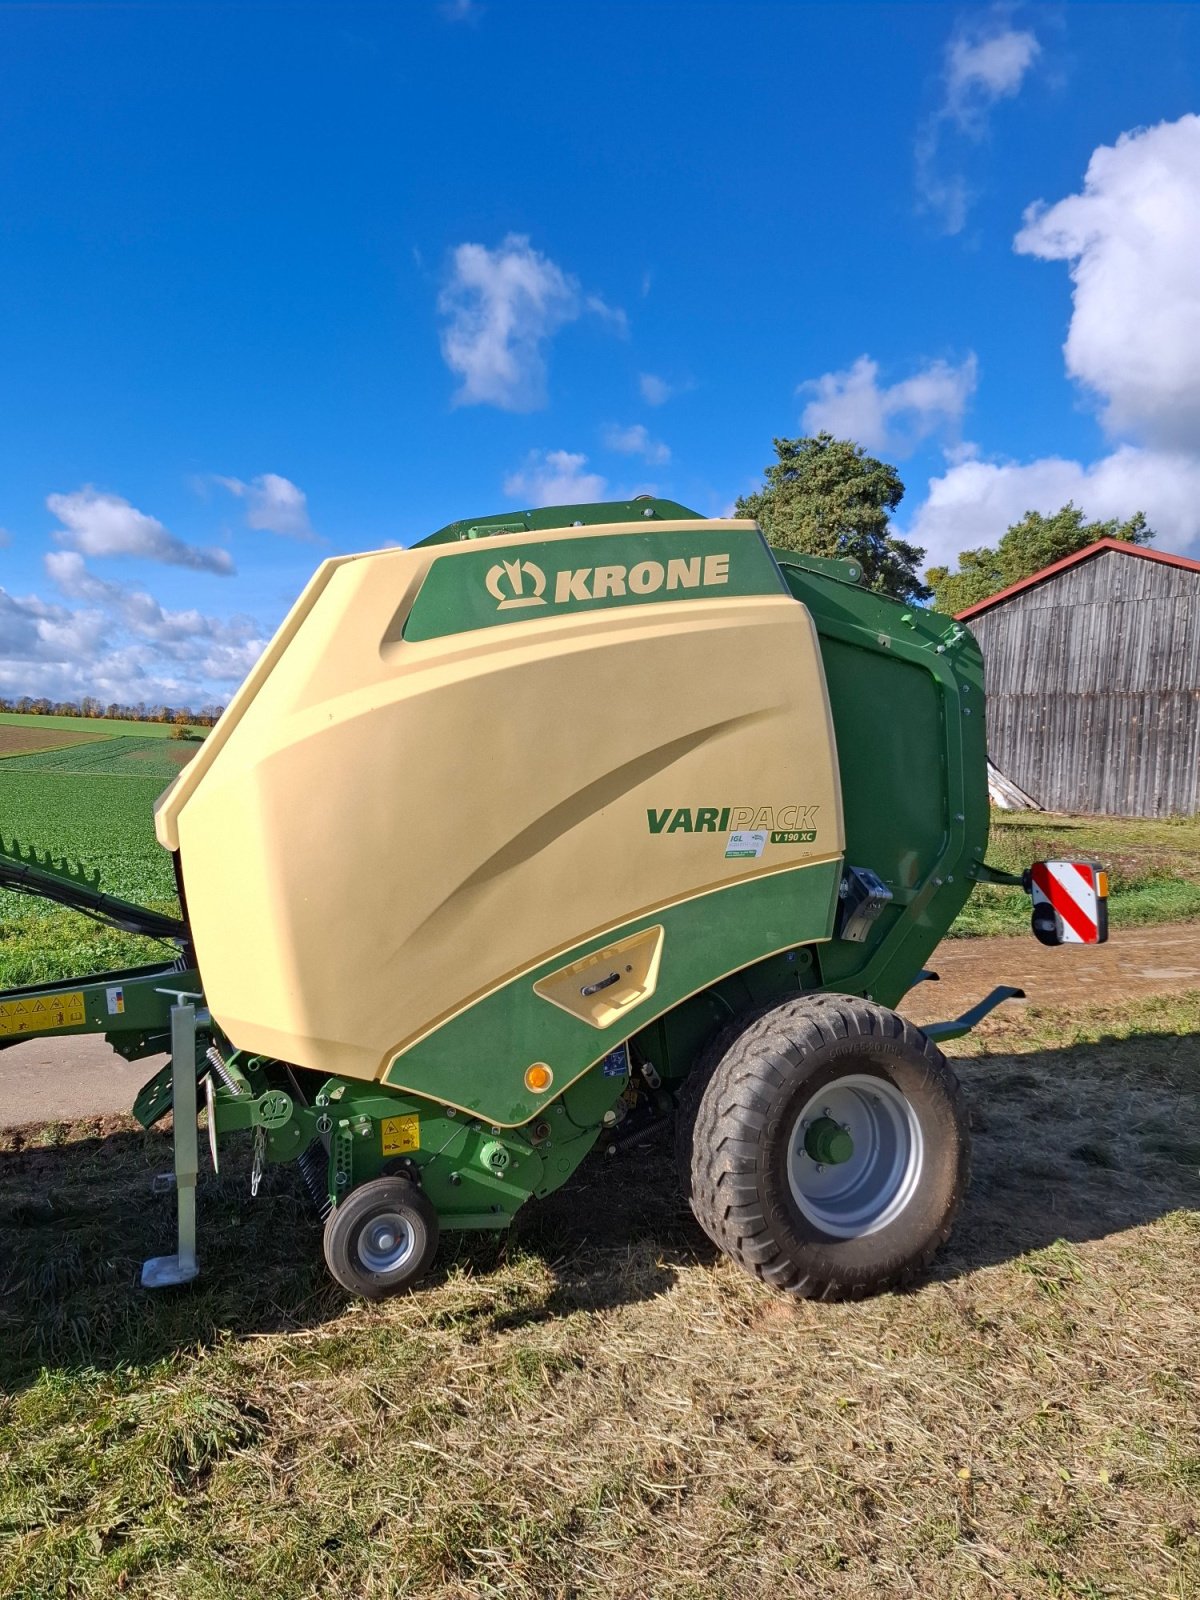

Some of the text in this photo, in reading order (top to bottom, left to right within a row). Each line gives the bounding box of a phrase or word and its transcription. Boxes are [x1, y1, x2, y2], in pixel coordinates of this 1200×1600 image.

[554, 553, 730, 604] KRONE
[647, 805, 820, 834] VARIPACK
[730, 835, 743, 843] IGL
[775, 832, 813, 842] V 190 XC
